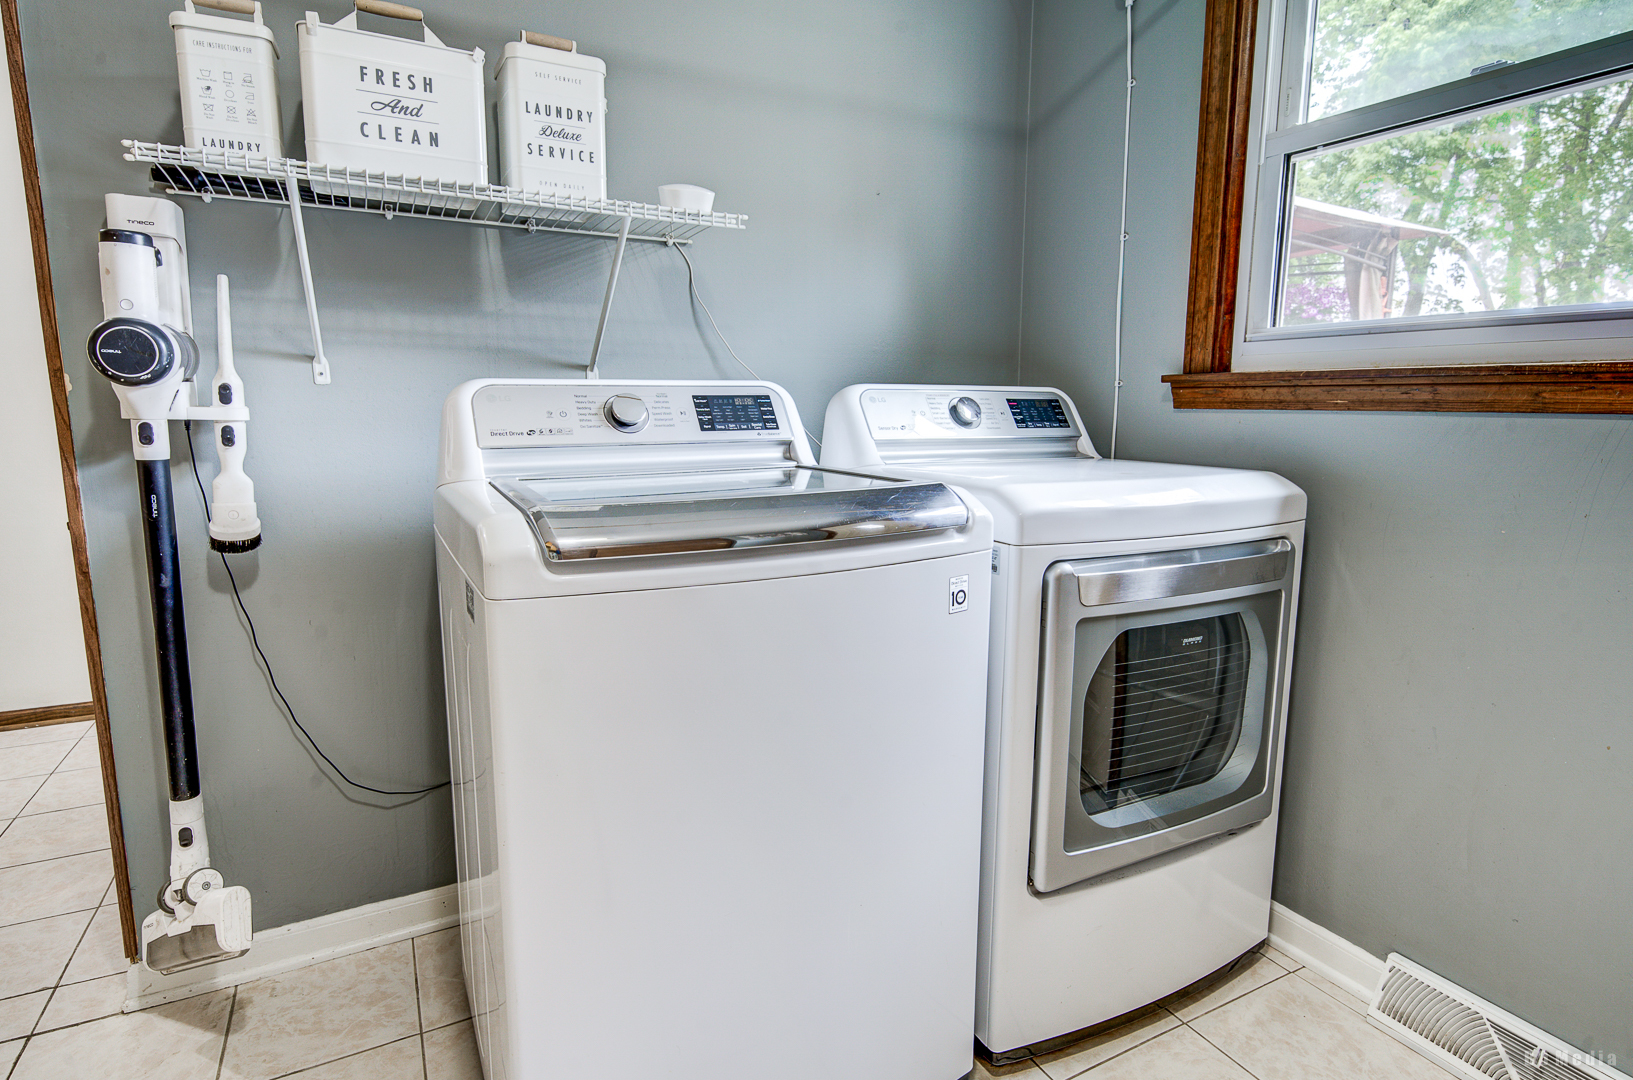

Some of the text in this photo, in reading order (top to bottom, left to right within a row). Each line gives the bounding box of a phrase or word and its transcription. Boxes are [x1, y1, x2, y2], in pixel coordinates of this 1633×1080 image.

[192, 39, 253, 55] CARE INSTRUCTIONS FOR
[359, 65, 433, 93] FRESH
[534, 71, 582, 86] SELF SERVICE
[370, 98, 424, 118] And
[525, 100, 593, 123] LAUNDRY
[359, 121, 439, 148] CLEAN
[538, 124, 583, 142] Deluxe
[202, 136, 261, 153] LAUNDRY
[526, 142, 595, 164] SERVICE
[539, 180, 585, 191] OPEN DAILY
[951, 589, 967, 607] 10
